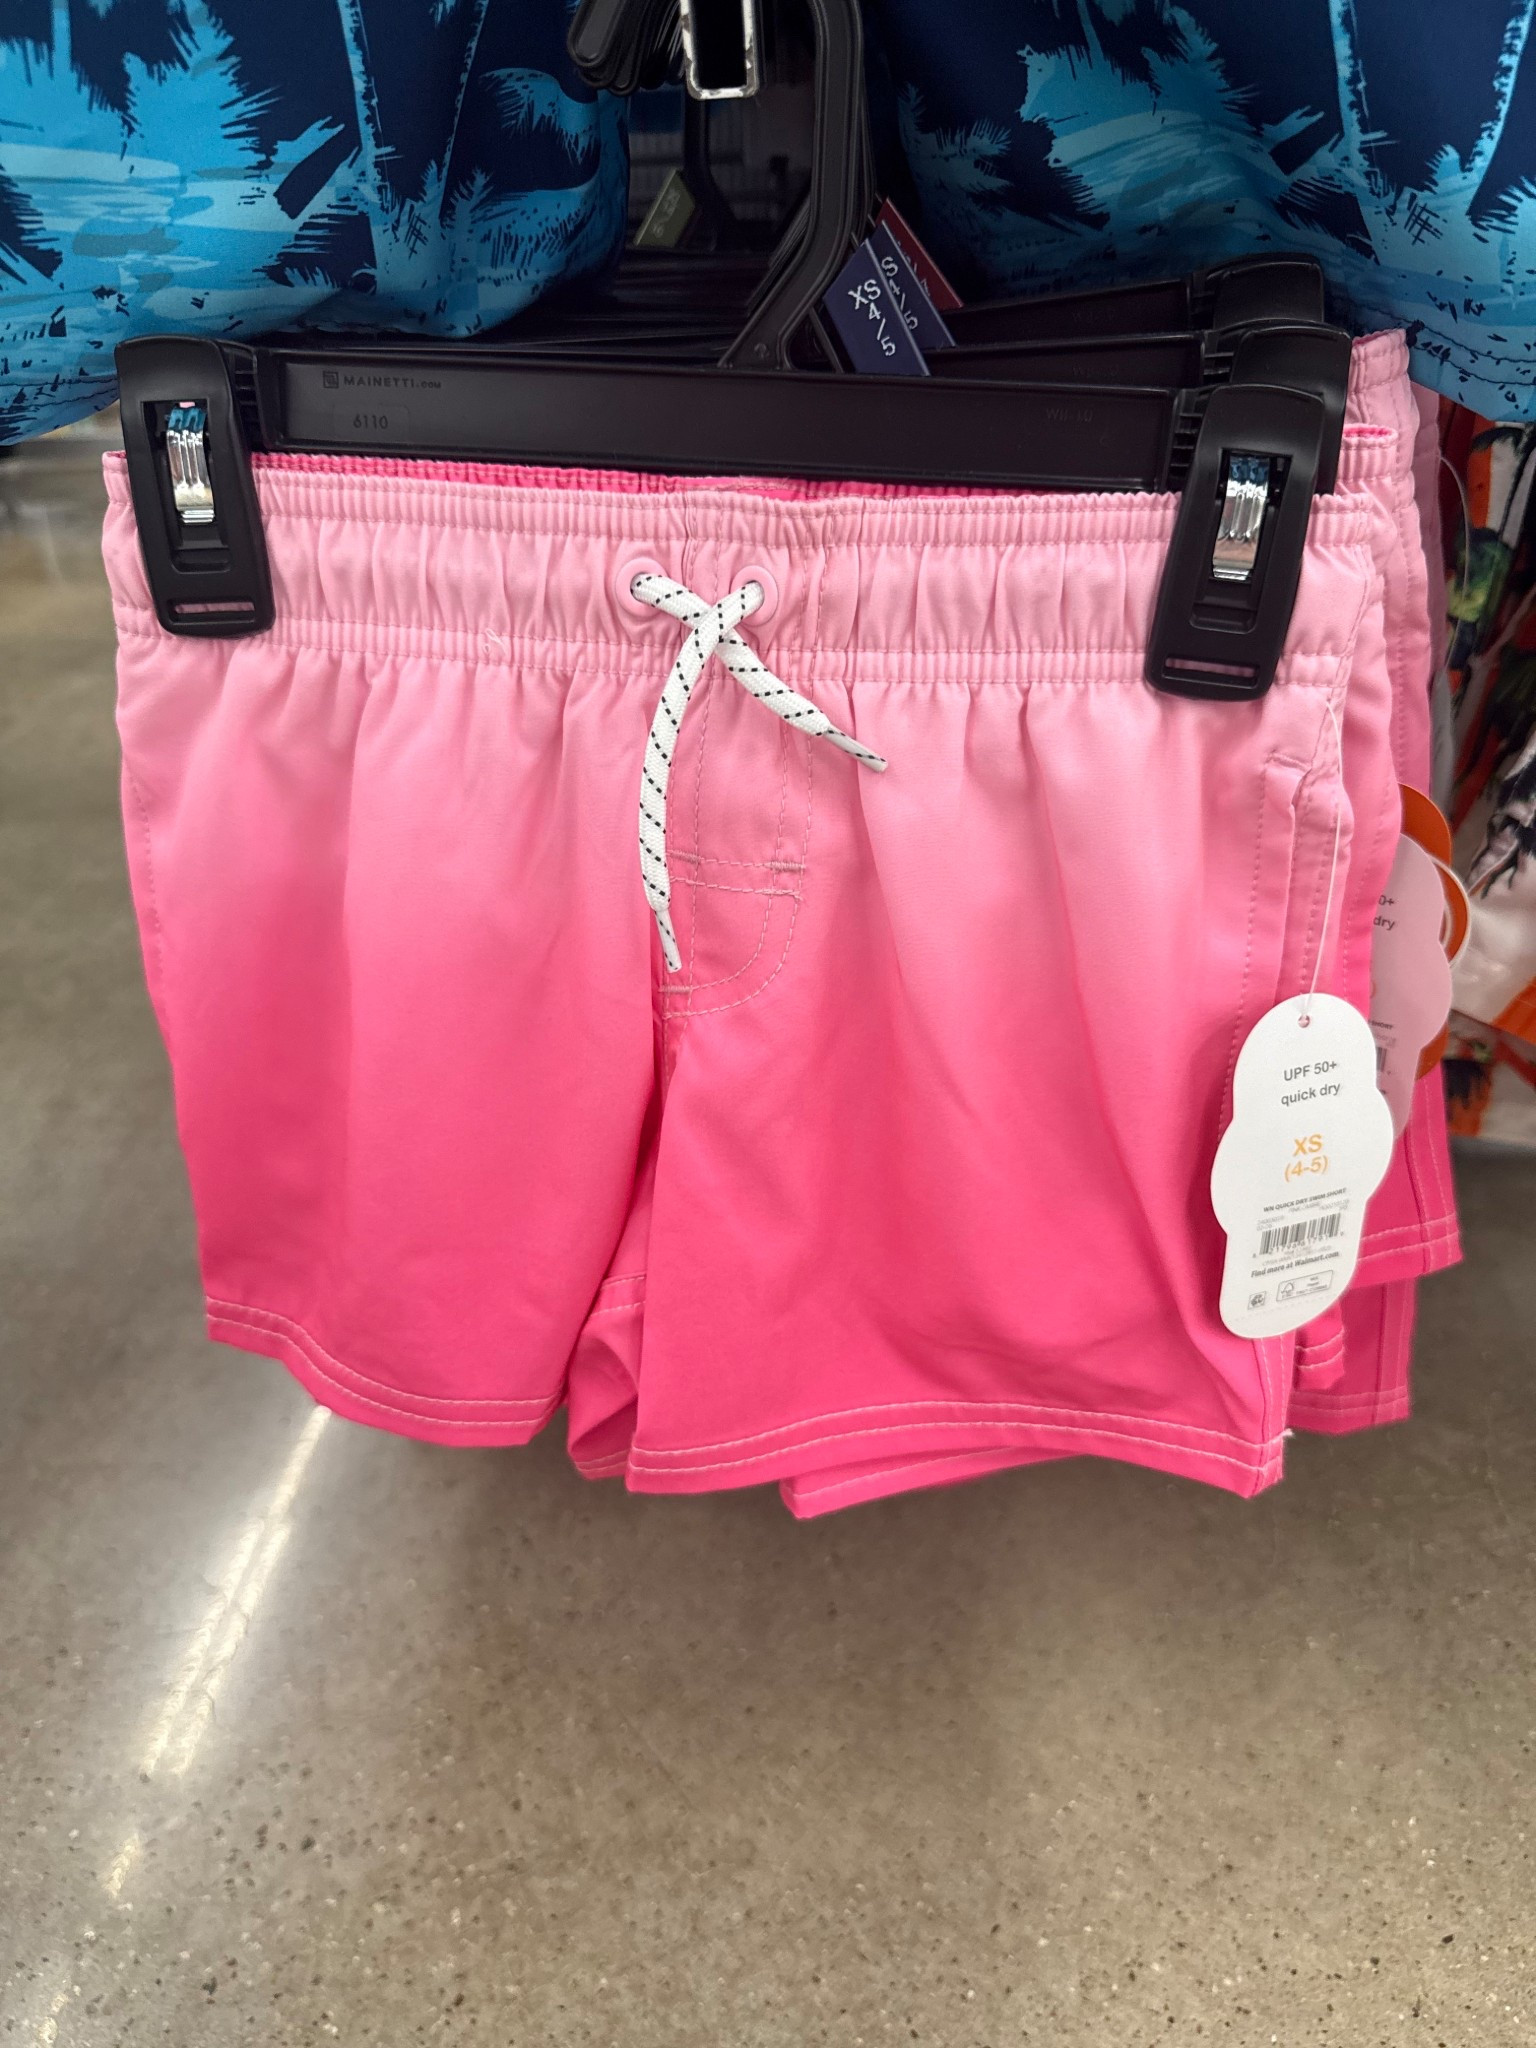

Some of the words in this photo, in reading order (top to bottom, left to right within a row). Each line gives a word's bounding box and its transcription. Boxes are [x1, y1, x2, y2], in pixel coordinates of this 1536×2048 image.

[848, 279, 882, 310] XS
[868, 302, 897, 357] 4/5
[353, 413, 389, 430] 6110
[1378, 895, 1395, 906] 0+
[1373, 915, 1396, 931] dry
[1283, 1064, 1311, 1082] UPF
[1314, 1060, 1338, 1075] 50+
[1281, 1087, 1317, 1107] quick
[1319, 1083, 1341, 1096] dry
[1292, 1133, 1323, 1158] XS
[1284, 1154, 1329, 1183] (4-5)
[1275, 1201, 1295, 1210] QUICK
[1295, 1197, 1308, 1205] DRY
[1309, 1193, 1326, 1202] SWIM
[1326, 1187, 1347, 1198] SHORT
[1251, 1269, 1266, 1278] Find
[1267, 1265, 1285, 1273] more
[1286, 1261, 1293, 1269] at
[1294, 1251, 1340, 1267] Walmart.com
